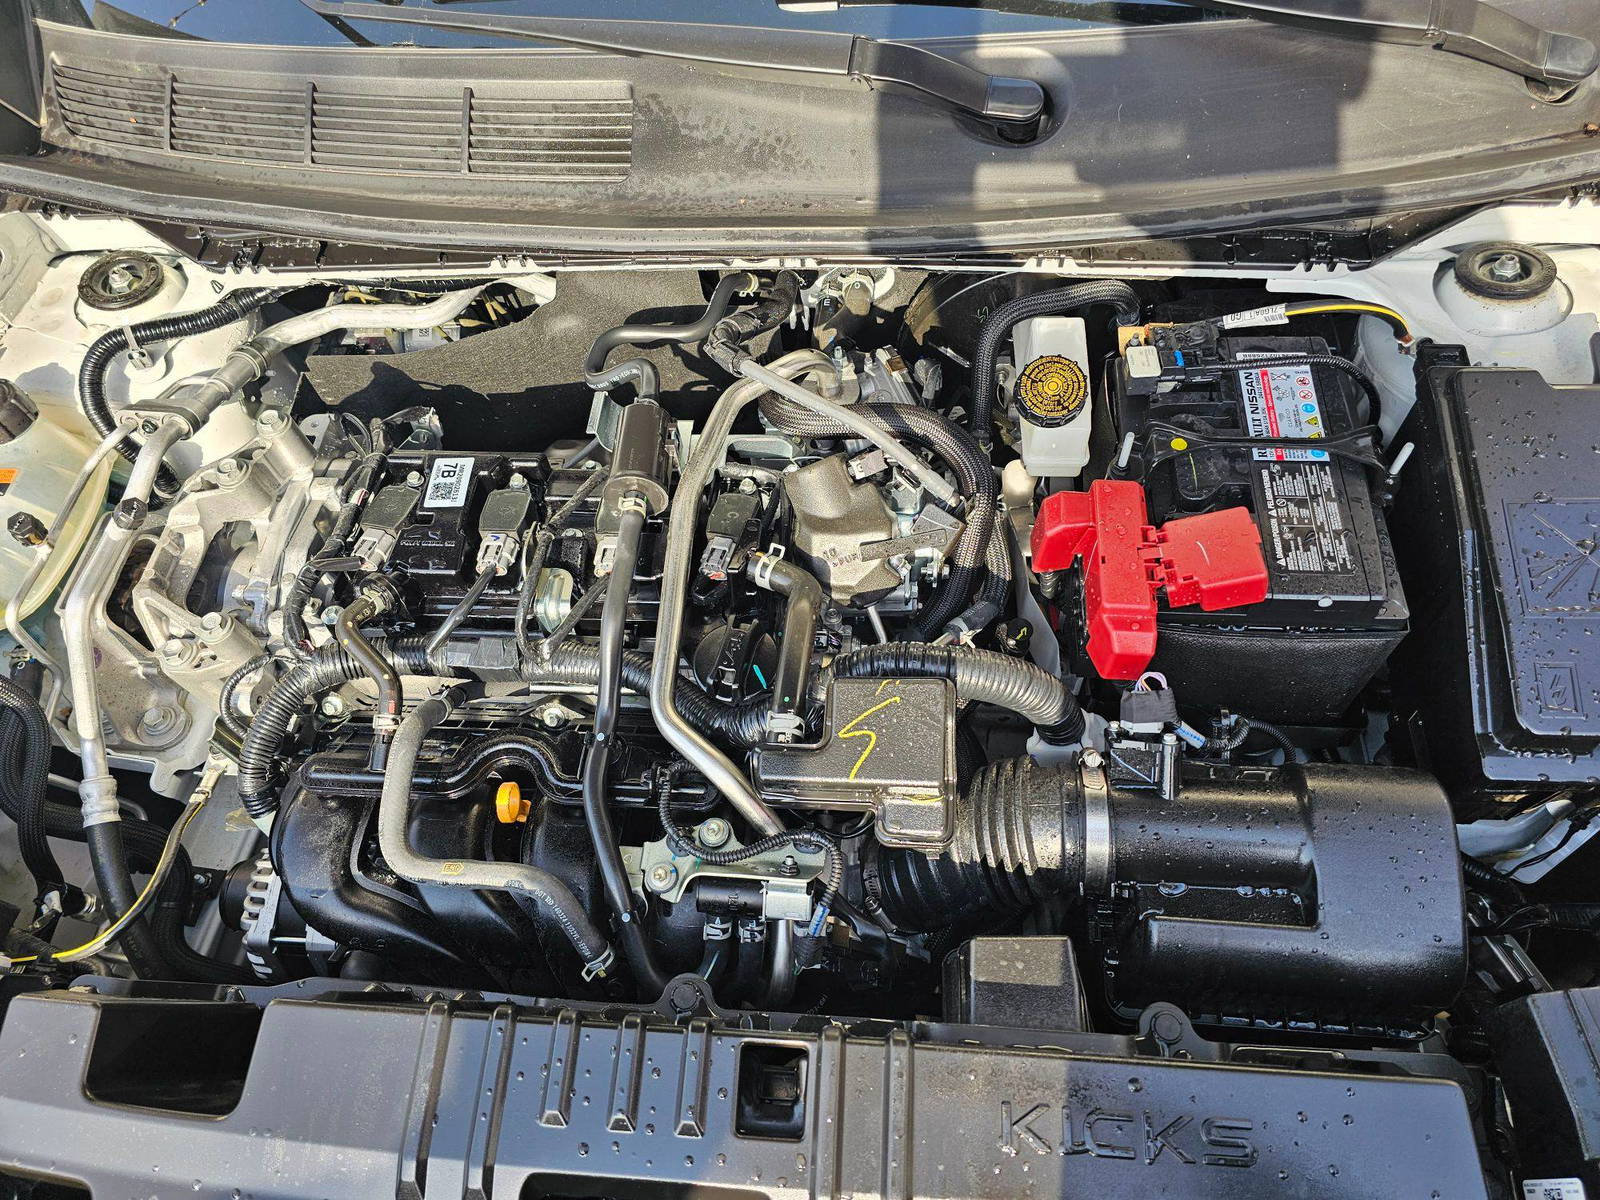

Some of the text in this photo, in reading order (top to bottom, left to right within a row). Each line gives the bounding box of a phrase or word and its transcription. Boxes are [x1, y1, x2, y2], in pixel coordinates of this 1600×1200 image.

[1243, 371, 1260, 415] NISSAN
[441, 462, 458, 479] 7B
[1000, 1100, 1259, 1168] KICKS
